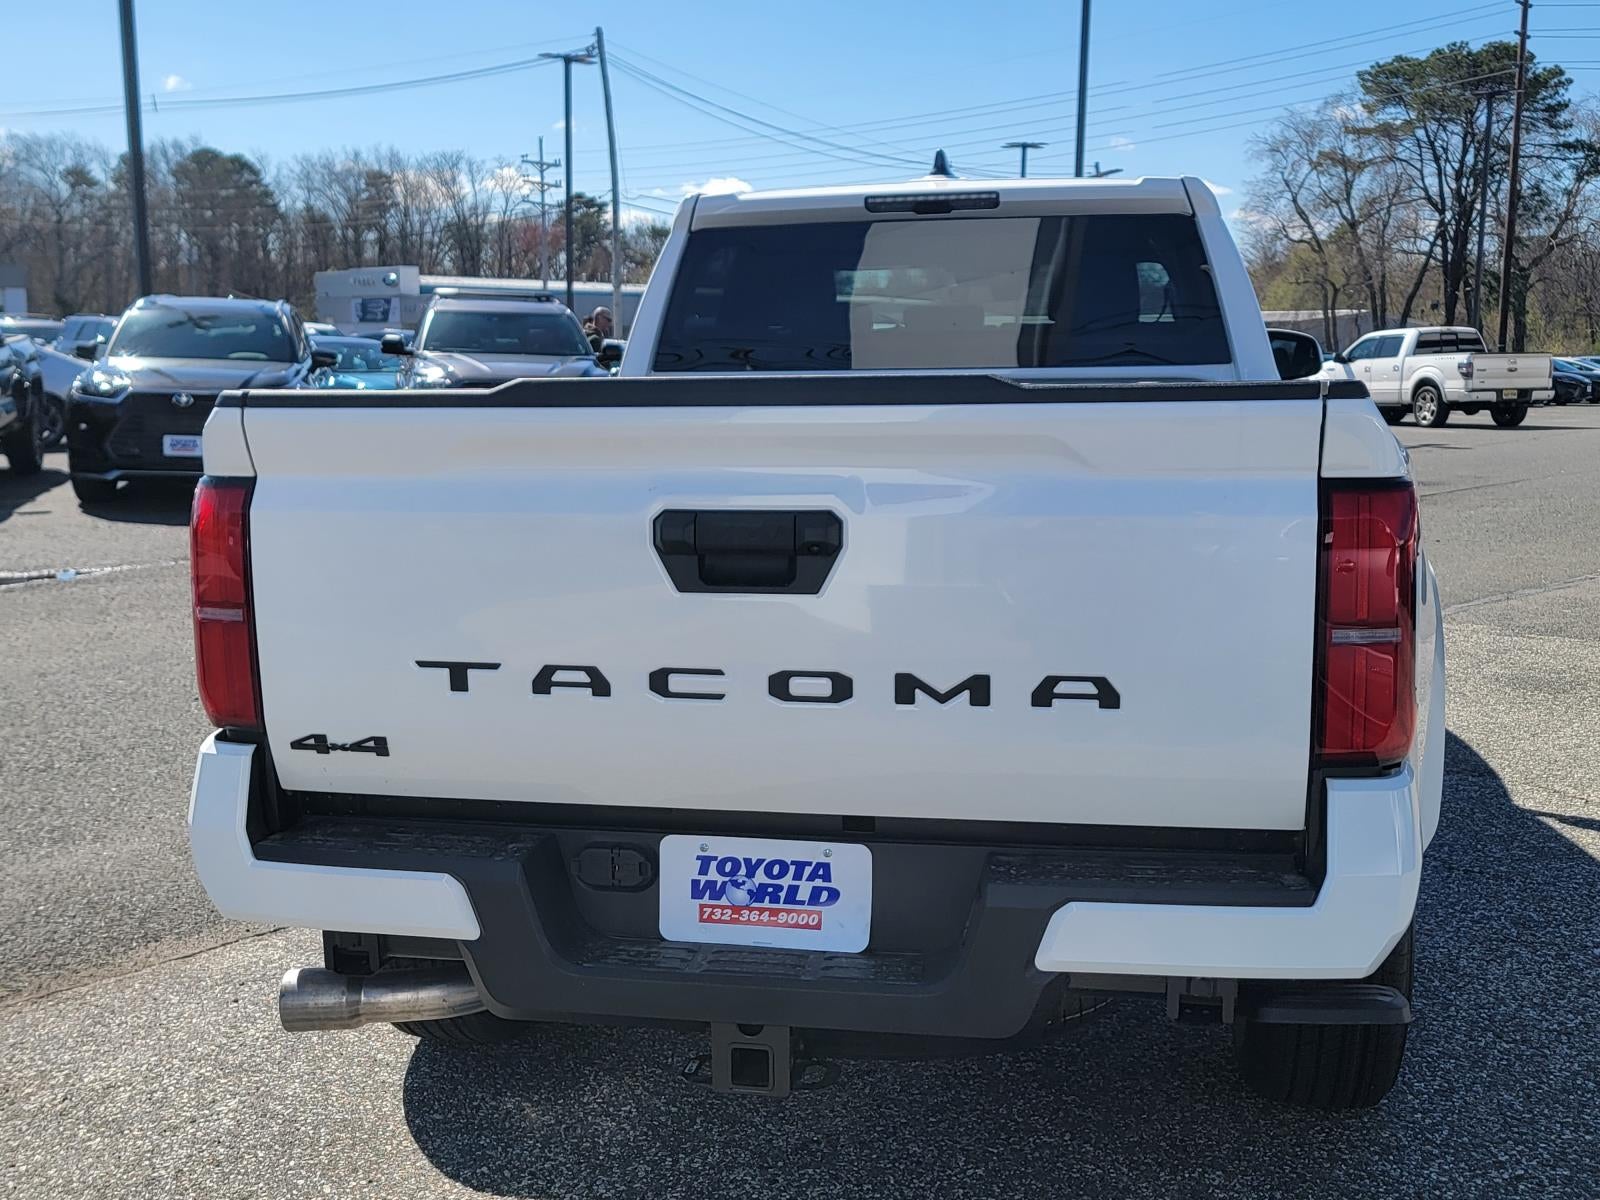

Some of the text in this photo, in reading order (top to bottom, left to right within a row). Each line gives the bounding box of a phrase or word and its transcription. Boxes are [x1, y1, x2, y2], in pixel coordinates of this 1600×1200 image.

[415, 661, 1120, 709] TACOMA
[696, 855, 832, 883] TOYOTA
[702, 907, 819, 925] 732-364-9000
